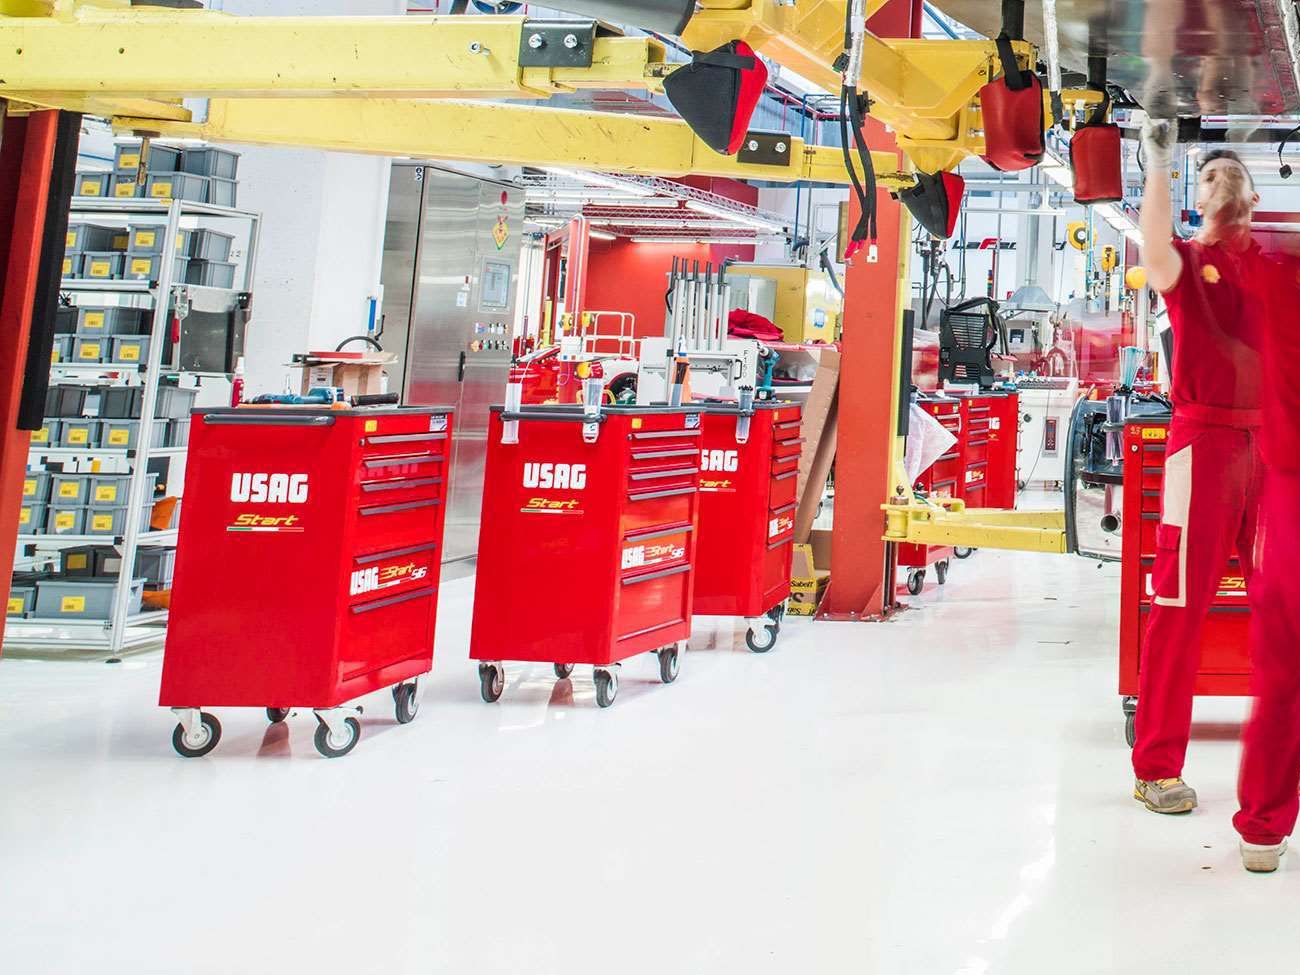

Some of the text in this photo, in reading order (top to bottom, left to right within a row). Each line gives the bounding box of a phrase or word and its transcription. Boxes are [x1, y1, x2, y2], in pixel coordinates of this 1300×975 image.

[700, 449, 739, 472] SAG
[523, 462, 587, 489] USAG
[699, 479, 732, 488] tart
[230, 472, 309, 503] USAG
[526, 497, 579, 509] Start
[234, 513, 299, 526] Start
[350, 566, 379, 596] USAG
[380, 562, 416, 580] Start
